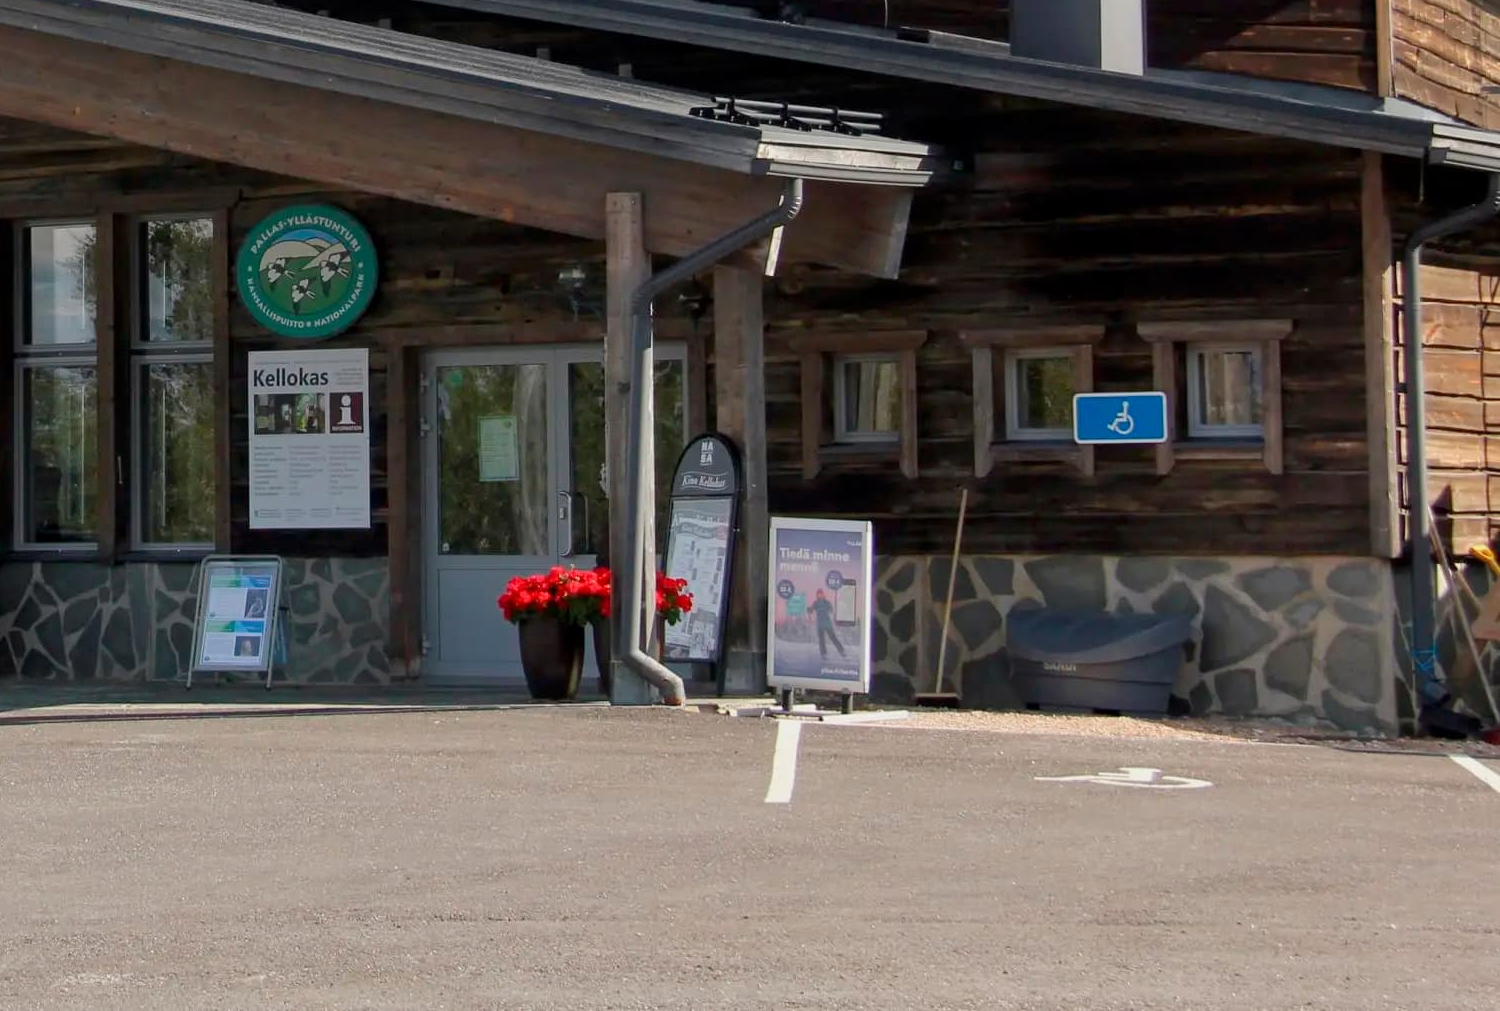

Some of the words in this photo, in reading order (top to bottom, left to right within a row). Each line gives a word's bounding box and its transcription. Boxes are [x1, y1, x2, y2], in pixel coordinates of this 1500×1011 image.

[247, 278, 304, 329] KANSALLISPUISTO
[314, 274, 364, 328] NATIONALPARK
[253, 367, 329, 387] Kellokas
[780, 547, 811, 560] Tiedä
[813, 549, 851, 562] minne
